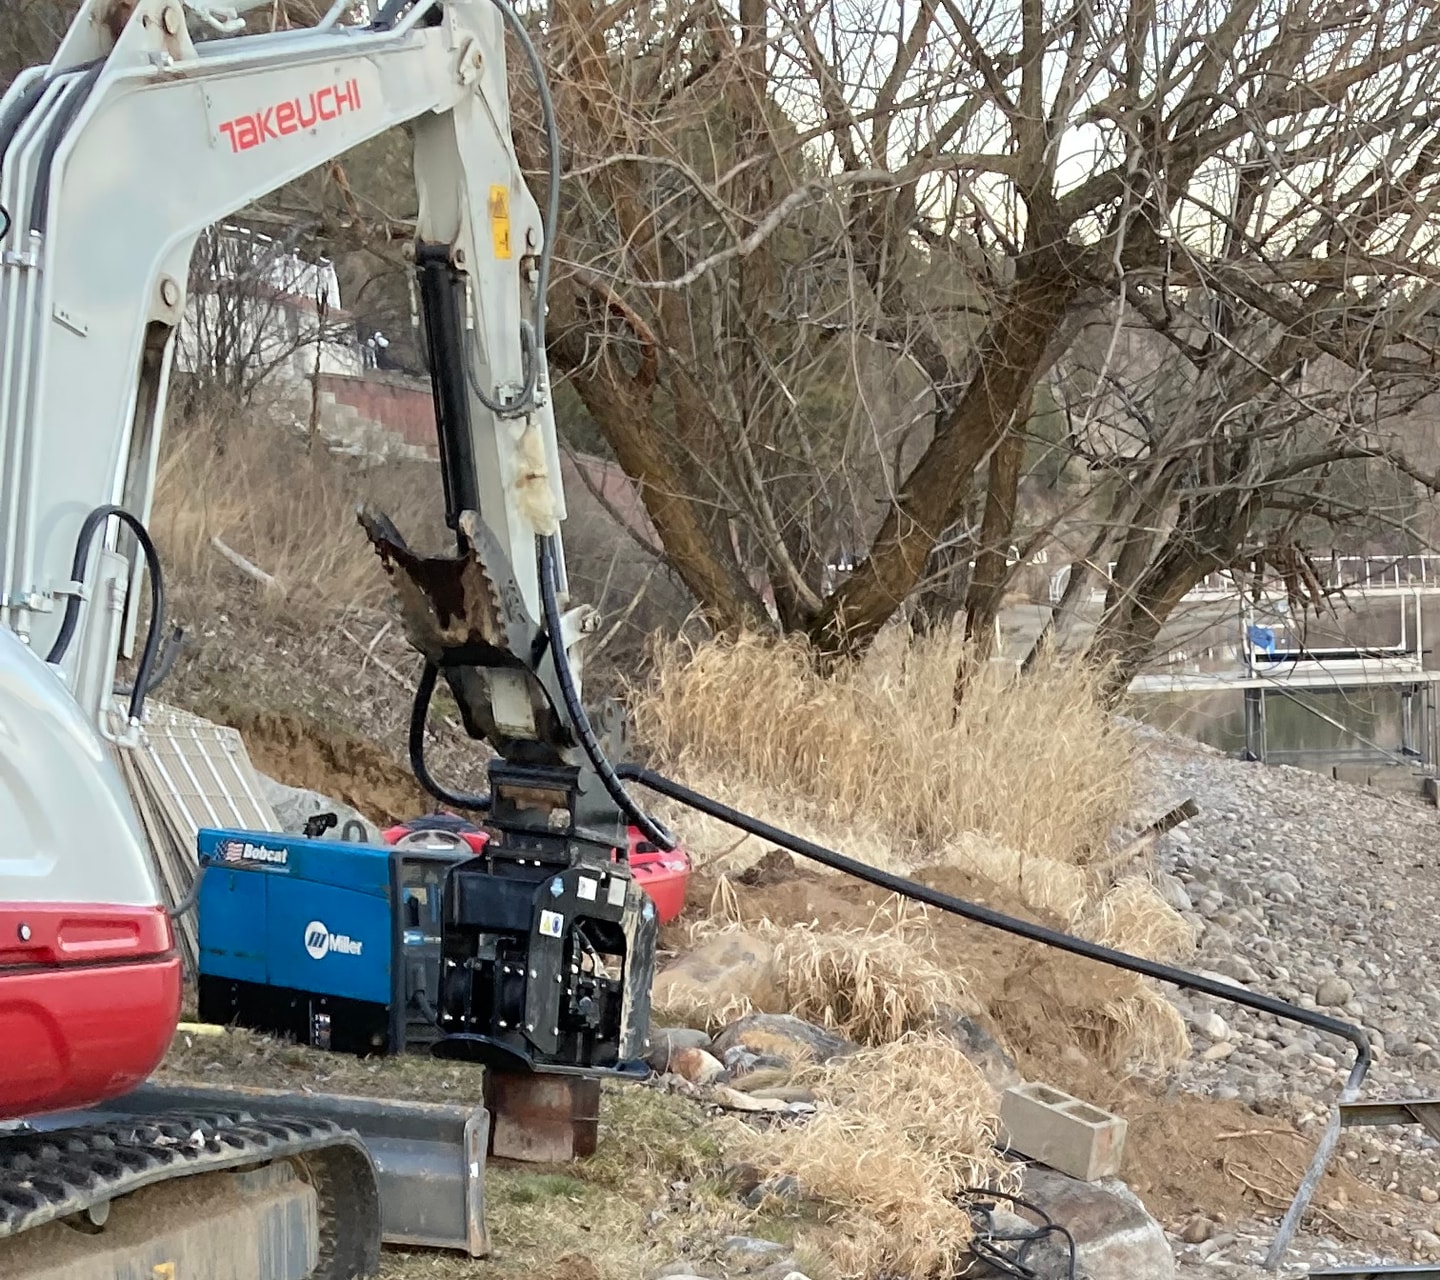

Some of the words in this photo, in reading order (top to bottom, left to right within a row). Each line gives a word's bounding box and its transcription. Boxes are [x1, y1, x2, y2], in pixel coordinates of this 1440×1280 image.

[219, 78, 361, 153] TAKEUCHI
[243, 843, 288, 864] Bobcat
[329, 933, 363, 956] Miller
